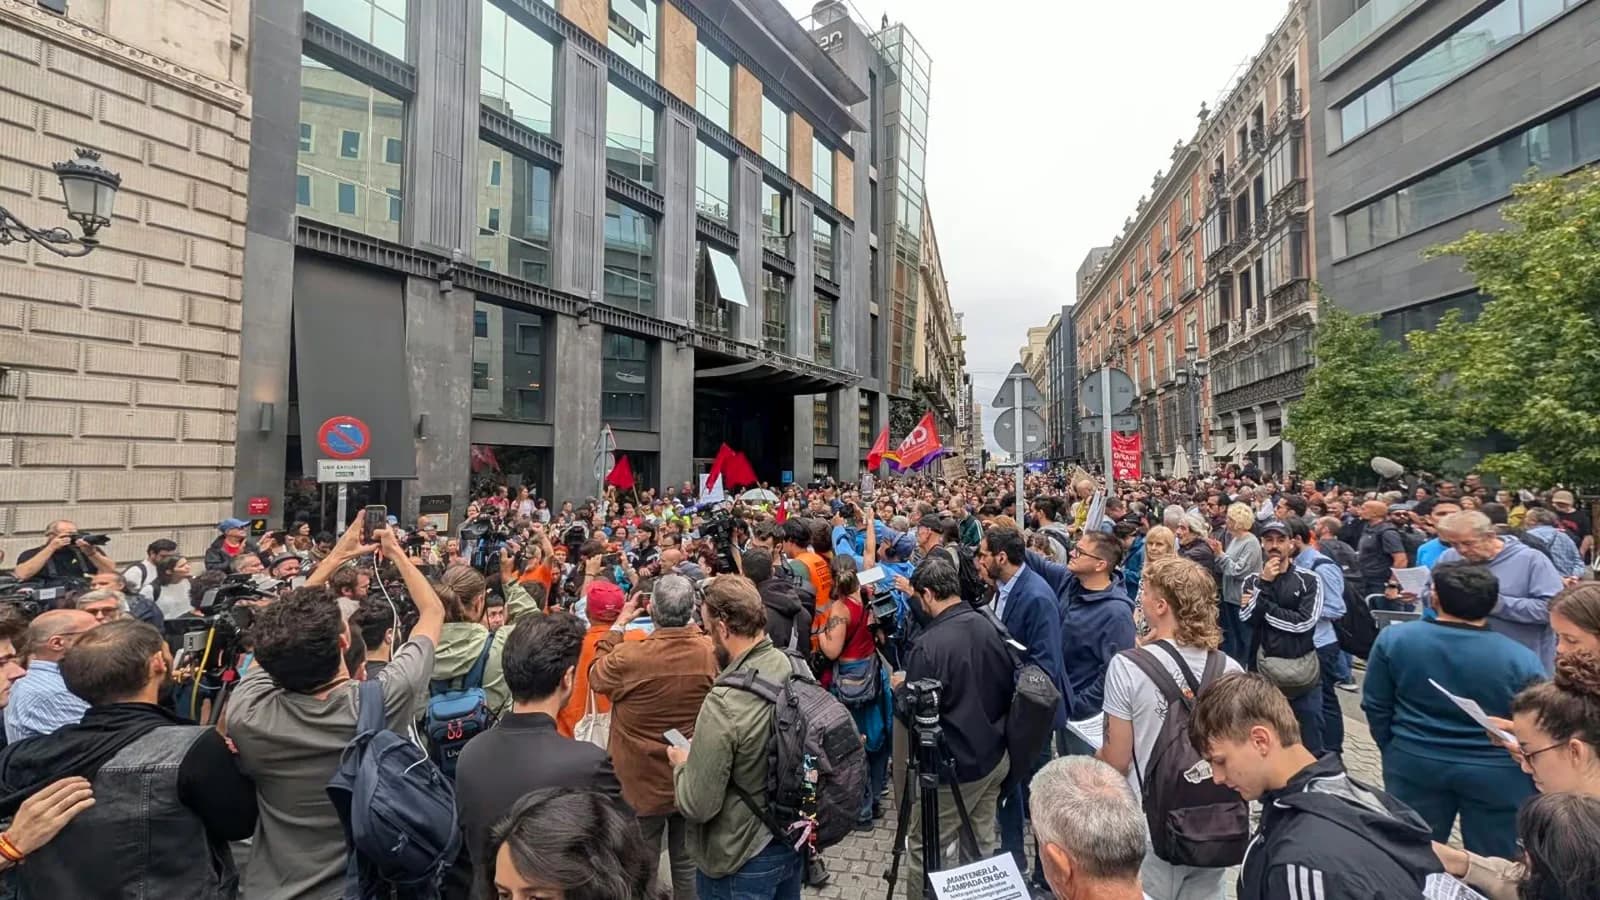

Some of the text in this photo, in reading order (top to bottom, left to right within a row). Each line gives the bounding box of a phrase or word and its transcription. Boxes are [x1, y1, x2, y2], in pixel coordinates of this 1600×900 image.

[988, 865, 999, 874] LA
[943, 870, 1009, 893] ACAMPADA EN SOL
